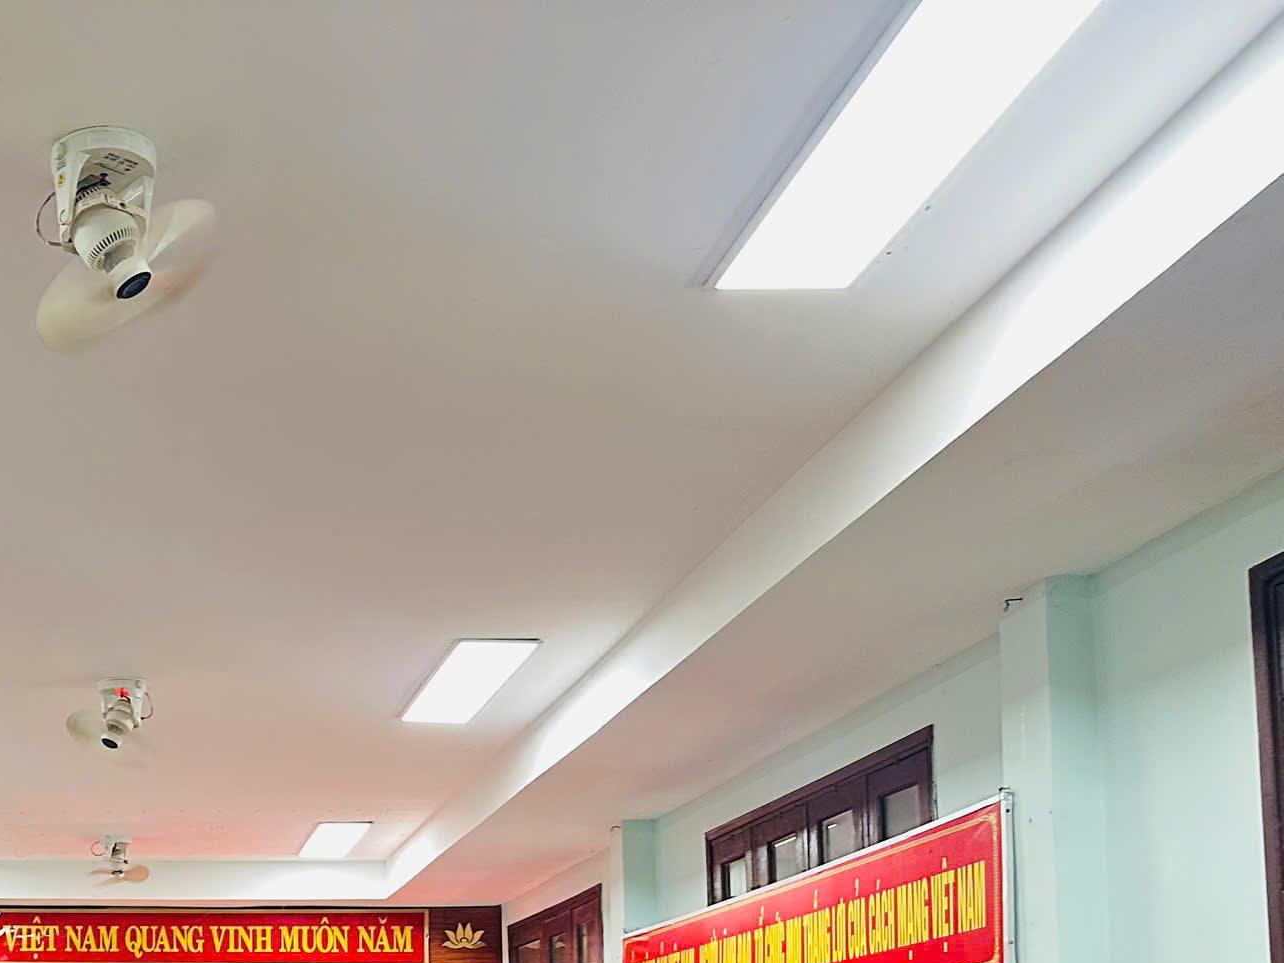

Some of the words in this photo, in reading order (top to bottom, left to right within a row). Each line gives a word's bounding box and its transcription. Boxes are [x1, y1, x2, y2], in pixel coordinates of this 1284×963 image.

[5, 915, 59, 960] VIỆT
[65, 924, 119, 952] NAM
[124, 925, 204, 958] QUANG
[210, 925, 273, 953] VINH
[279, 917, 350, 953] MUÔN
[357, 916, 414, 953] NĂM
[847, 878, 867, 960] CỦA
[868, 879, 895, 954] CÁCH
[897, 877, 929, 960] MẠNG
[930, 857, 955, 952] VIỆT
[956, 860, 986, 933] NAM
